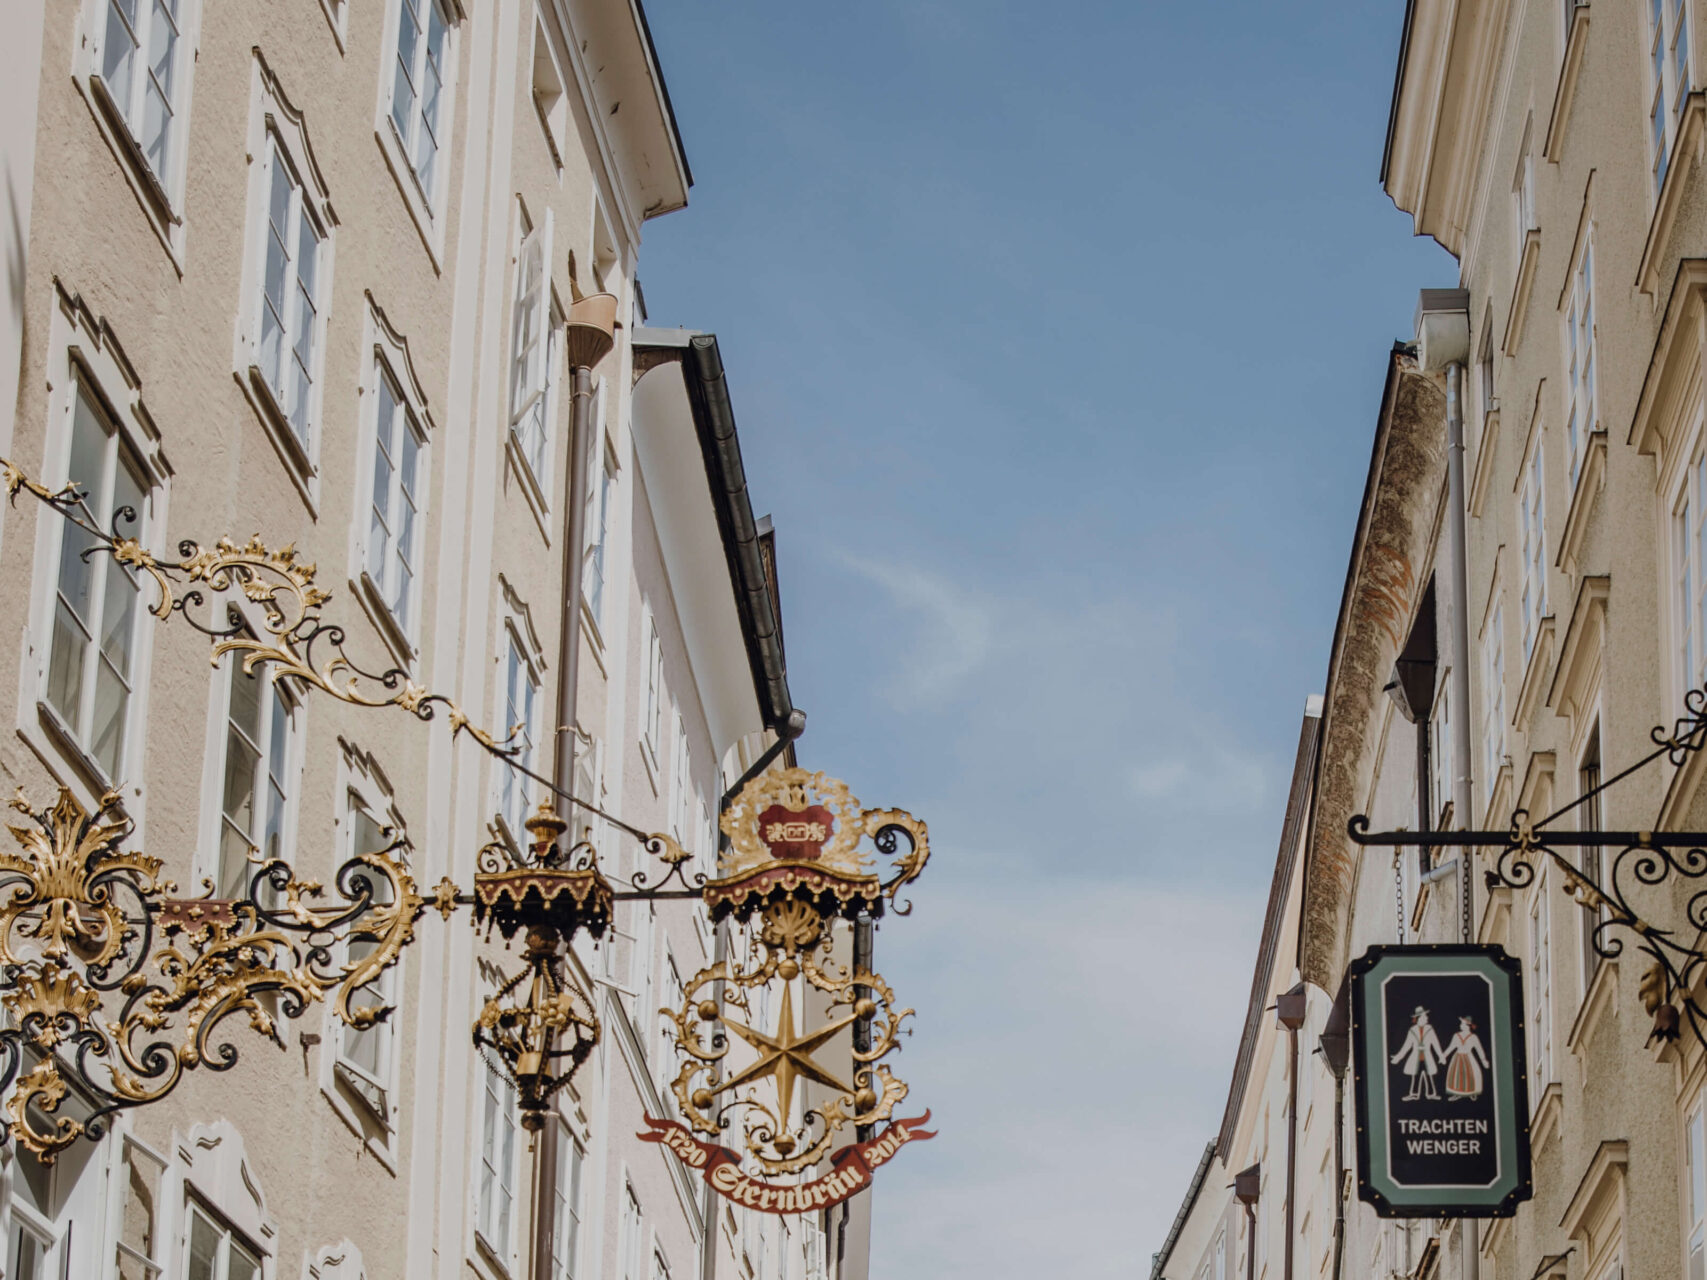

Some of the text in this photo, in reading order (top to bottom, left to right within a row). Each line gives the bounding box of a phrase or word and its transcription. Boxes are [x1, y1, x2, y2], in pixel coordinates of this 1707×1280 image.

[661, 1126, 708, 1167] 1720
[863, 1124, 912, 1166] 2014
[1398, 1119, 1487, 1134] TRACHTEN
[1406, 1139, 1481, 1154] WENGER
[711, 1162, 865, 1211] Sternbräu
